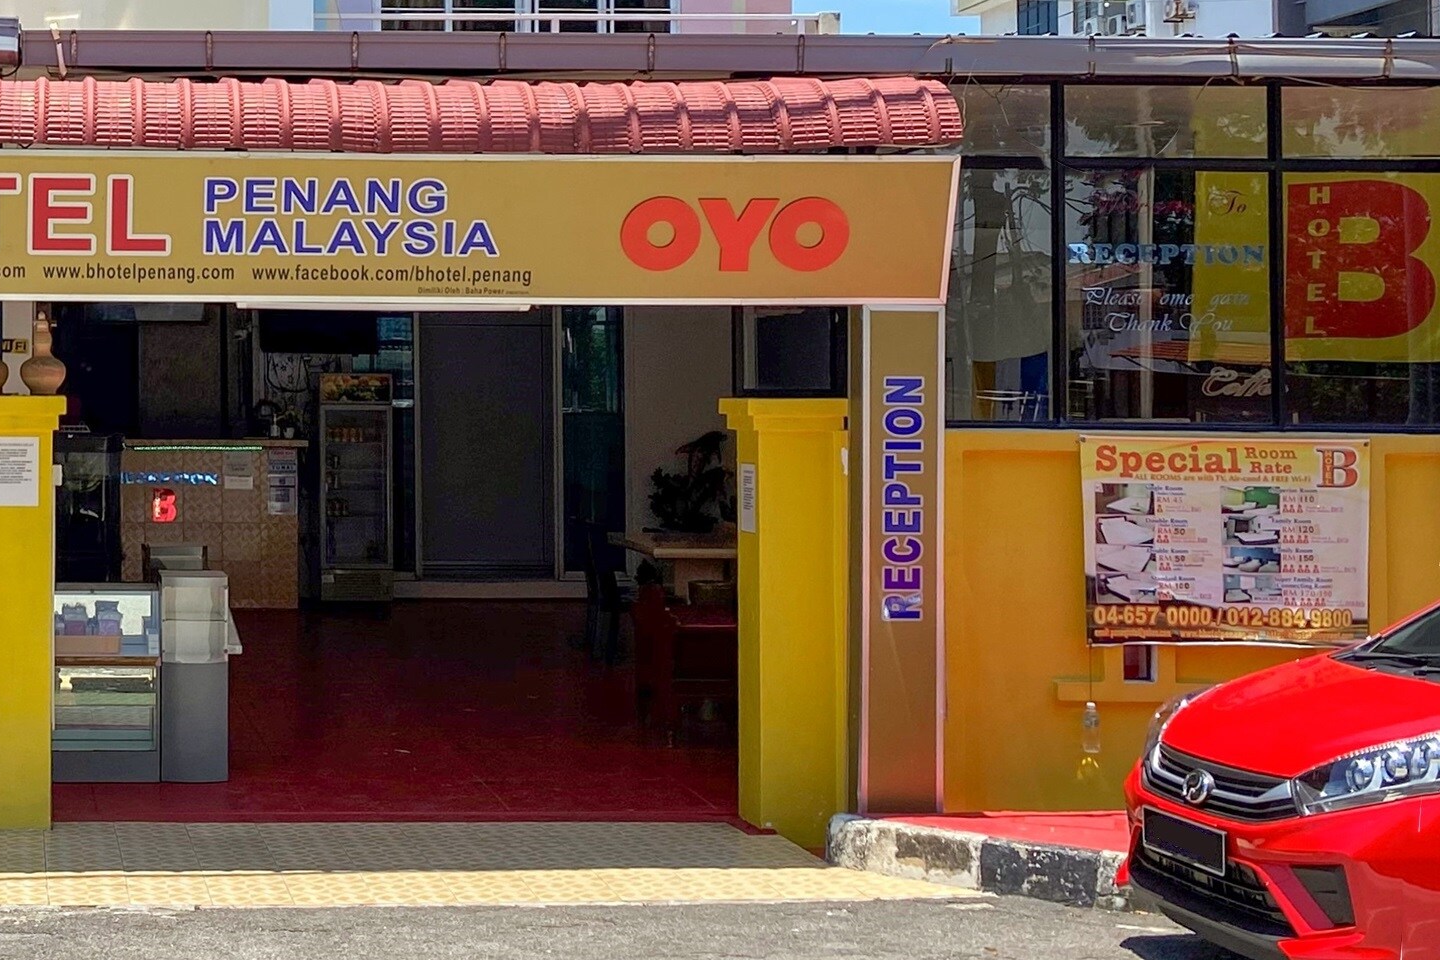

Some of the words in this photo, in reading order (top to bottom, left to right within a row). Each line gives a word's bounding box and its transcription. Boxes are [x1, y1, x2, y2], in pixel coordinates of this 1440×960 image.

[203, 176, 447, 215] PENANG
[203, 217, 500, 258] MALAYSIA
[620, 195, 850, 272] OYO
[1068, 243, 1265, 266] RECEPTION
[1285, 179, 1437, 340] B
[1305, 186, 1331, 335] HOTEL
[43, 263, 235, 282] www.bhotelpenang.com
[252, 265, 532, 286] www.facebook.com/bhotel.penang
[1104, 312, 1173, 332] Thank
[1179, 313, 1233, 340] You
[1095, 445, 1242, 478] Special
[1244, 447, 1298, 460] Room
[1250, 461, 1292, 474] Rate
[1316, 448, 1358, 488] B
[152, 488, 177, 523] B
[881, 375, 925, 621] RECEPTION
[1093, 606, 1159, 625] 04-657
[1166, 606, 1211, 626] 0000
[1226, 608, 1307, 627] 012-884
[1311, 608, 1352, 627] 9800
